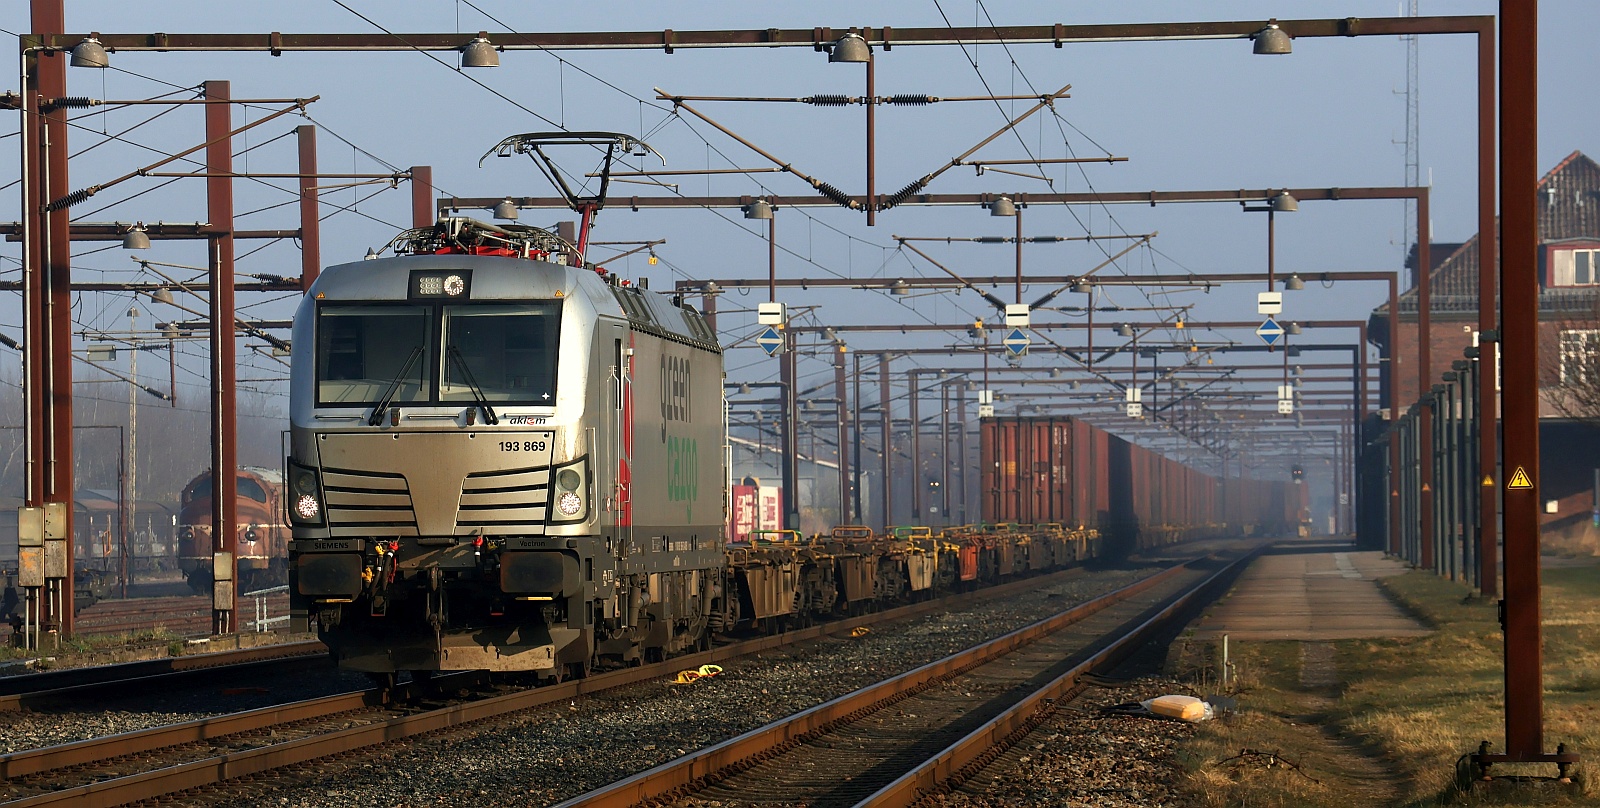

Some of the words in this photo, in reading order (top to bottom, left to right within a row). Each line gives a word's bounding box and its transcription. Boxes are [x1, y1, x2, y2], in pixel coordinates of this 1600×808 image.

[660, 353, 691, 444] green
[498, 441, 520, 451] 193
[523, 441, 546, 451] 869
[667, 434, 697, 524] cargo
[314, 542, 349, 550] SIEMENS
